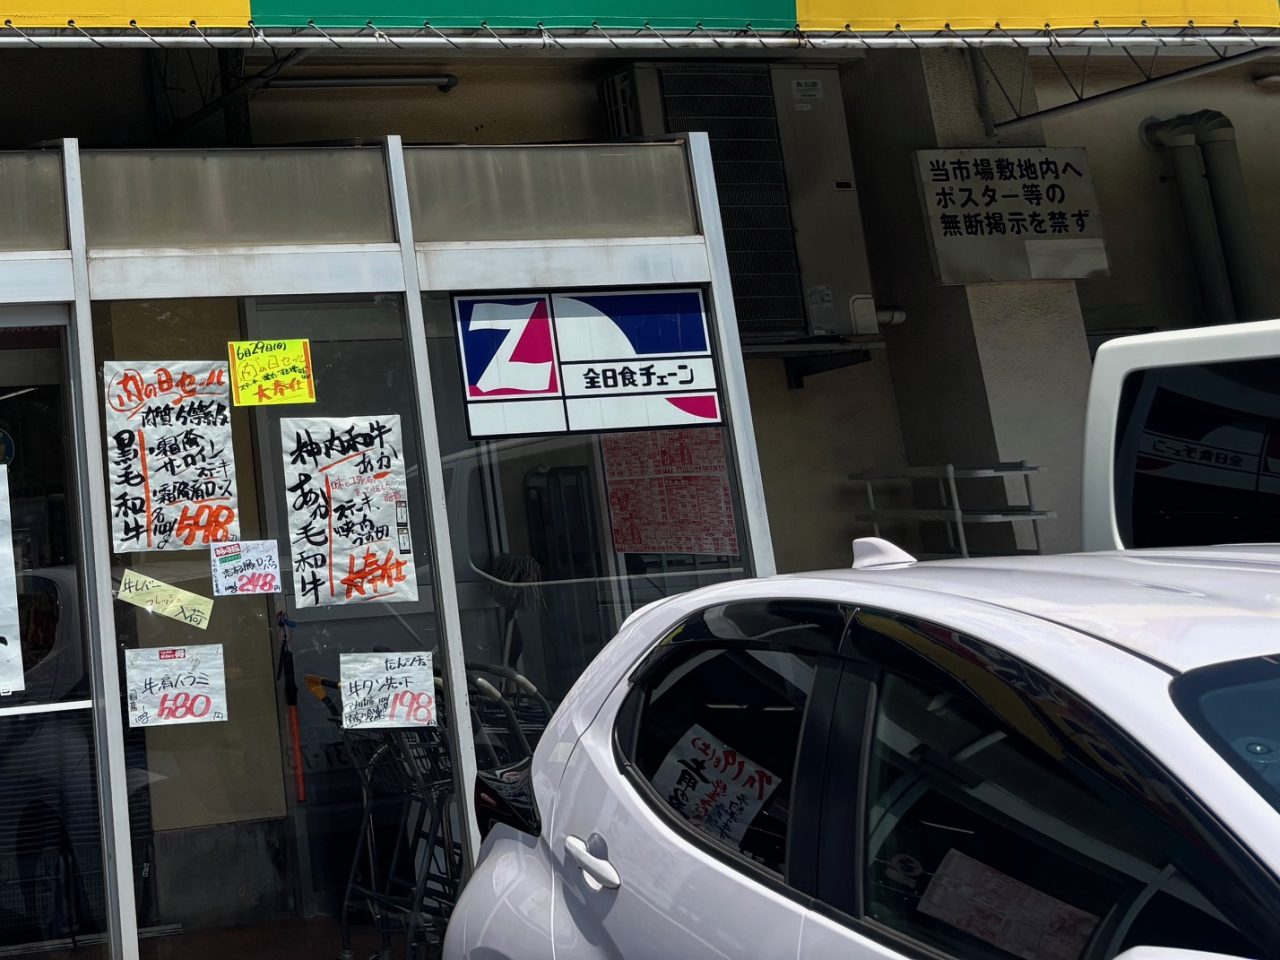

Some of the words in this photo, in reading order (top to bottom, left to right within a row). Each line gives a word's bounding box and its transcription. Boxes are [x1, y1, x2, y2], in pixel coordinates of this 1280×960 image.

[929, 157, 1083, 182] 当市場敷地内へ
[935, 183, 1066, 209] ポスター等の
[940, 209, 1090, 237] 無断掲示を禁ず
[583, 364, 694, 390] 全日食チェーン
[113, 429, 148, 545] 黒毛和牛
[389, 690, 433, 722] 198
